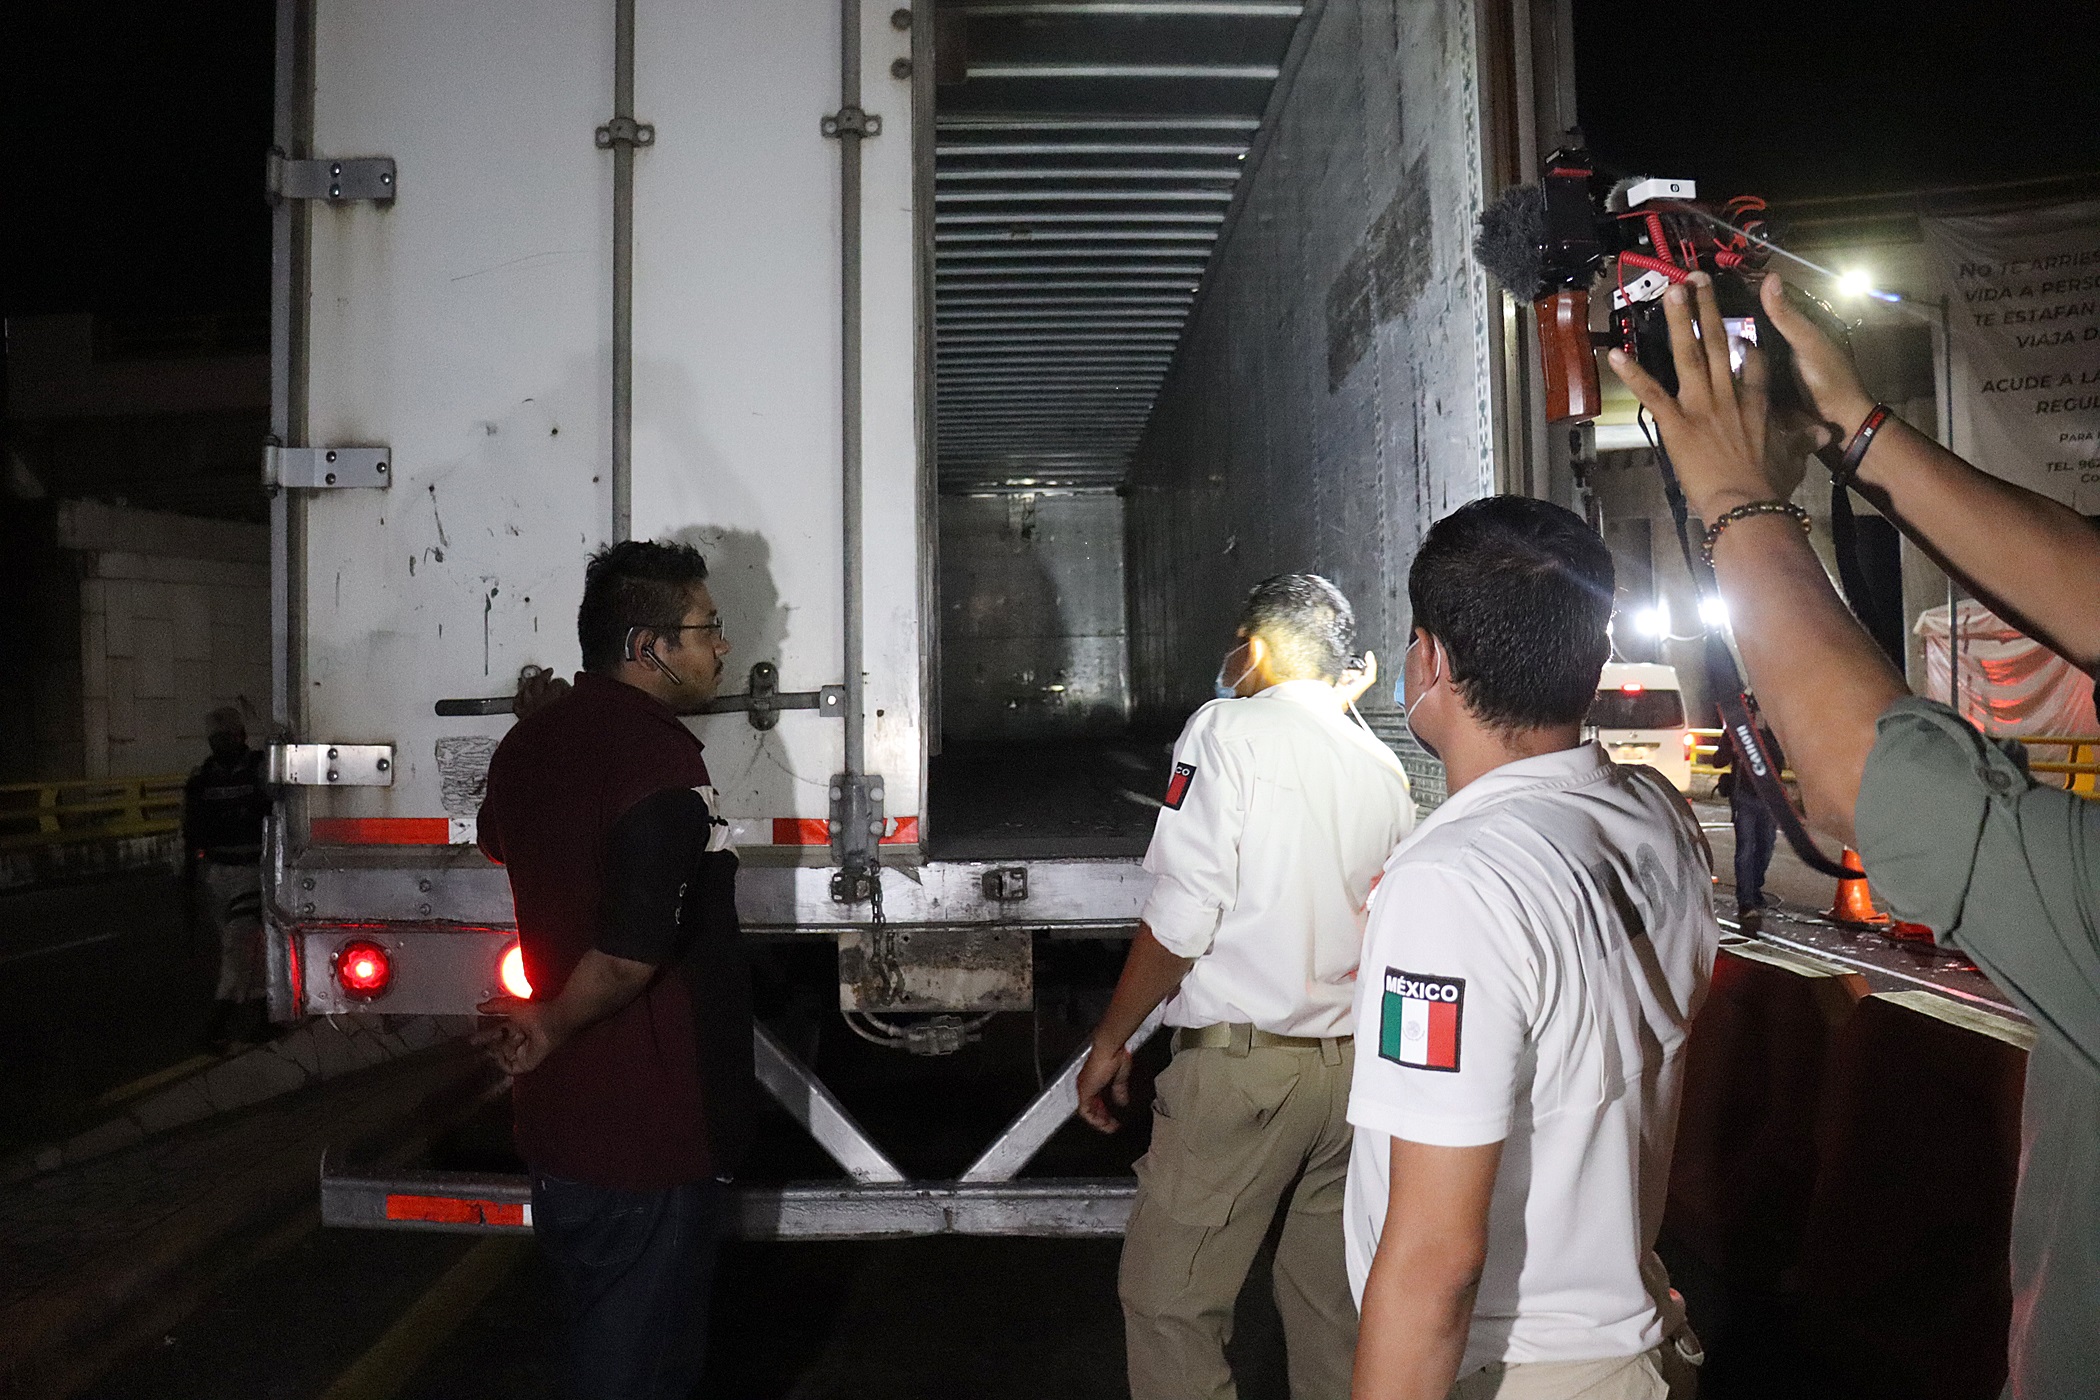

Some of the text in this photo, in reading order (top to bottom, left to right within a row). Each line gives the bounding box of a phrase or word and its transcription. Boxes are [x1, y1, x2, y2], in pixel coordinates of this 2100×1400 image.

[1960, 263, 1992, 277] NO
[1966, 287, 2012, 302] VIDA
[2019, 285, 2034, 298] A
[1974, 301, 2096, 327] TE ESTAFAN
[2016, 330, 2075, 348] VIAJA
[1981, 375, 2052, 393] ACUDE
[2059, 373, 2073, 387] A
[2060, 432, 2093, 443] PARA
[1385, 974, 1459, 1003] MÉXICO
